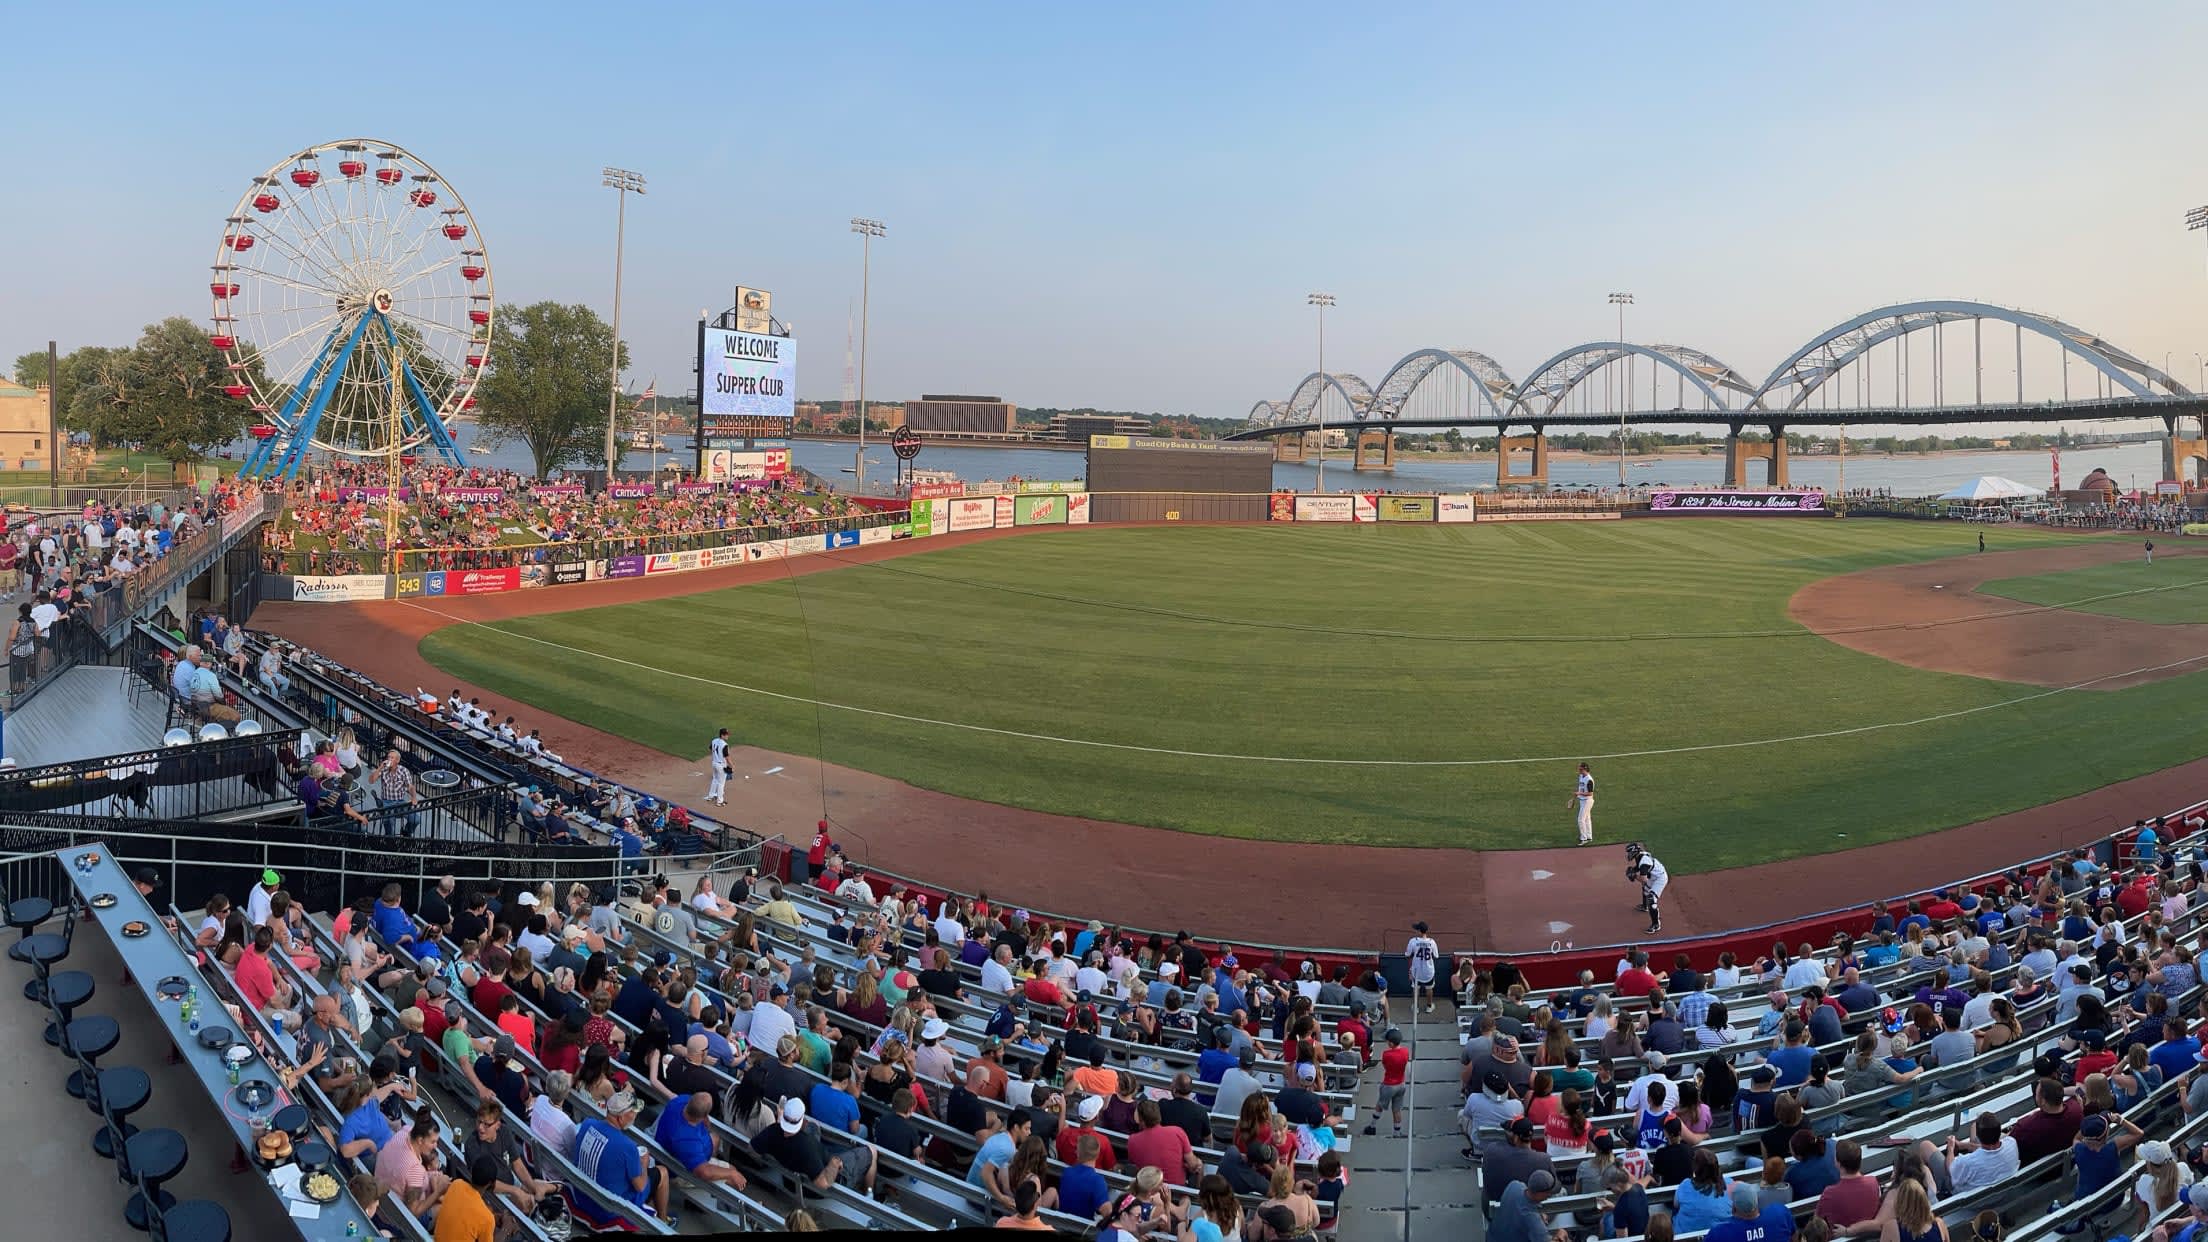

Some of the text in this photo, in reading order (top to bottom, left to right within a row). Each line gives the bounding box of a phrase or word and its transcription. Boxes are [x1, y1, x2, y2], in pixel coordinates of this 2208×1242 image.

[725, 335, 779, 359] WELCOME
[717, 373, 784, 397] SUPPER CLUB
[1156, 440, 1170, 449] City
[1171, 441, 1190, 449] Bank
[615, 489, 646, 498] CRITICAL
[1680, 496, 1706, 507] 1824
[1708, 496, 1724, 508] 7th
[1724, 495, 1753, 507] Street
[1763, 496, 1797, 507] Moline
[1166, 511, 1179, 520] 400
[712, 554, 730, 562] Safety
[296, 578, 348, 597] Radisson
[399, 579, 420, 593] 343
[431, 579, 442, 588] 42
[1416, 947, 1431, 960] 46
[1934, 1001, 1942, 1012] 8
[1640, 1128, 1666, 1141] O'NEA
[1746, 1227, 1764, 1241] DAD
